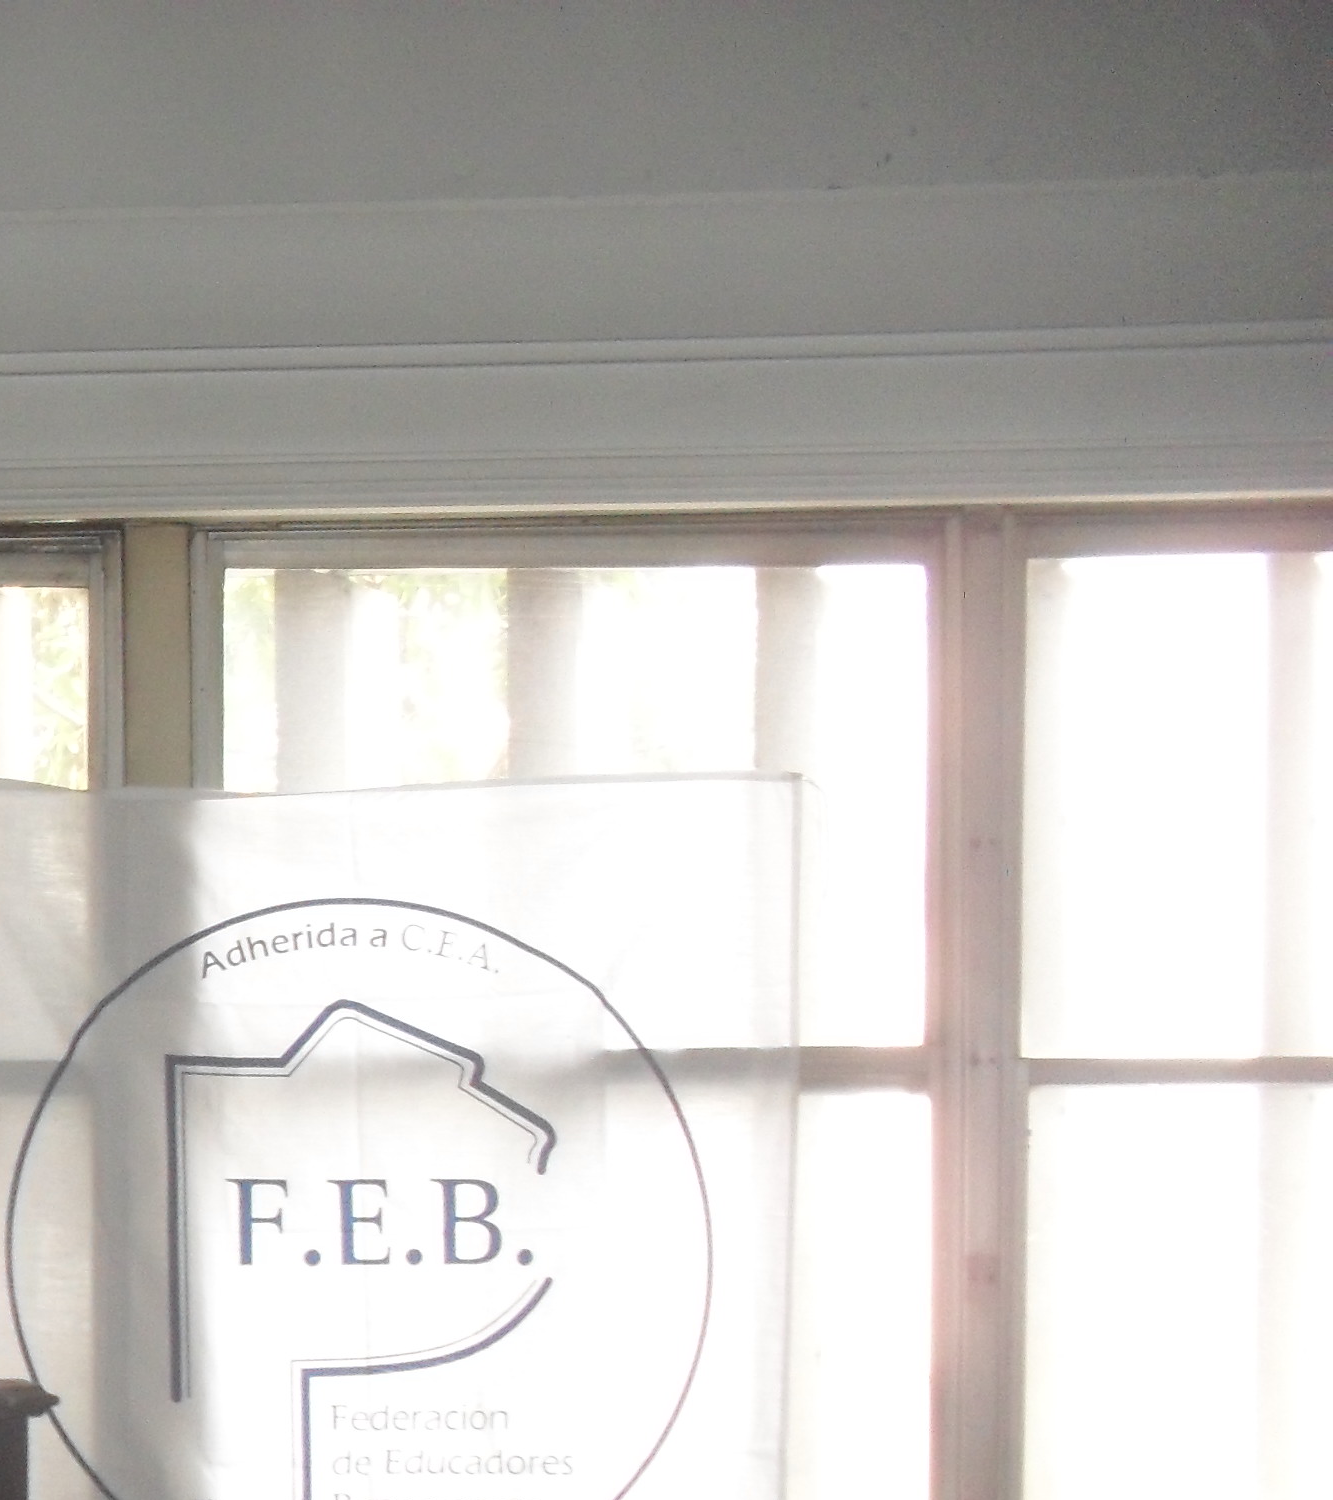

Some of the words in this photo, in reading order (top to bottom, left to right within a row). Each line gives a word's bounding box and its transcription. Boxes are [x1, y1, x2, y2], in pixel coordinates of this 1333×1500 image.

[199, 921, 359, 981] Adherida
[368, 926, 389, 948] a
[224, 1176, 535, 1268] F.E.B.
[331, 1402, 509, 1433] Federación
[331, 1449, 373, 1476] de
[383, 1448, 574, 1477] Educadores
